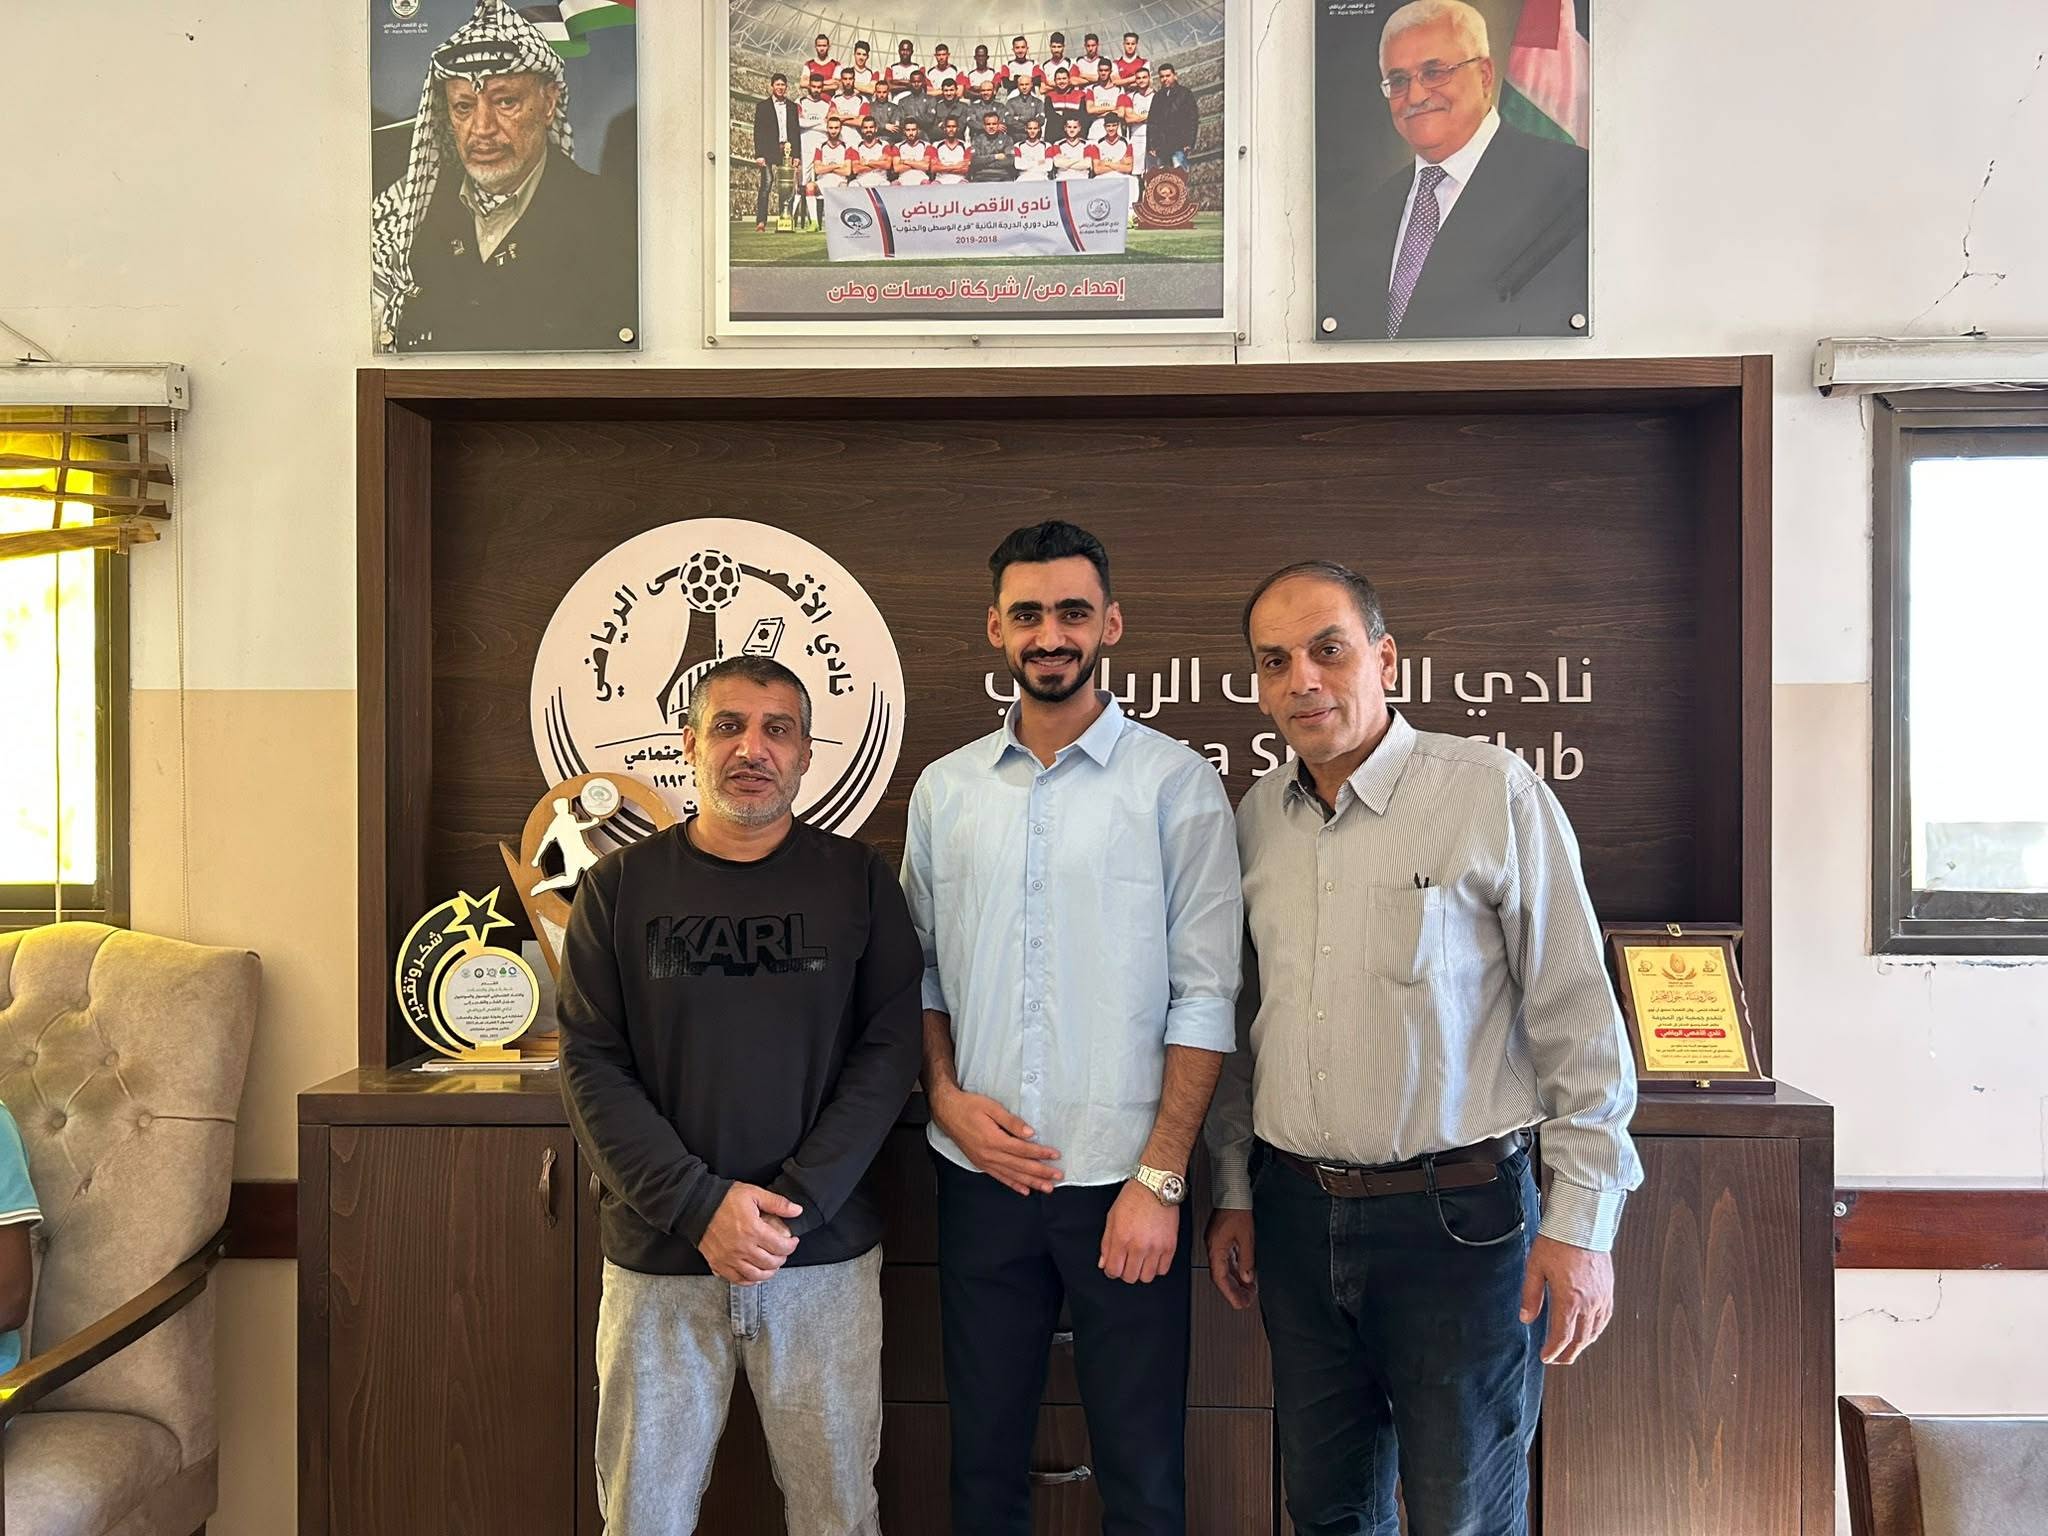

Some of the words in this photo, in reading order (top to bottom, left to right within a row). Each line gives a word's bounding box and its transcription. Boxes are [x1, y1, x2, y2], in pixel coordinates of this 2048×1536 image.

[902, 201, 959, 223] الرياضي
[963, 197, 1014, 216] الأقصى
[1018, 196, 1051, 219] نادي
[1023, 222, 1042, 231] دوري
[956, 236, 998, 244] 2019-2018
[827, 281, 880, 303] وطن
[881, 280, 956, 299] لمسات
[960, 276, 1020, 303] شركة
[1071, 277, 1126, 301] إهداء
[584, 585, 638, 701] الرياضي
[806, 634, 854, 696] نادي
[1454, 656, 1592, 717] نادي
[653, 774, 687, 788] ١٩٩٣
[413, 931, 443, 969] شكر
[646, 912, 827, 978] KARL
